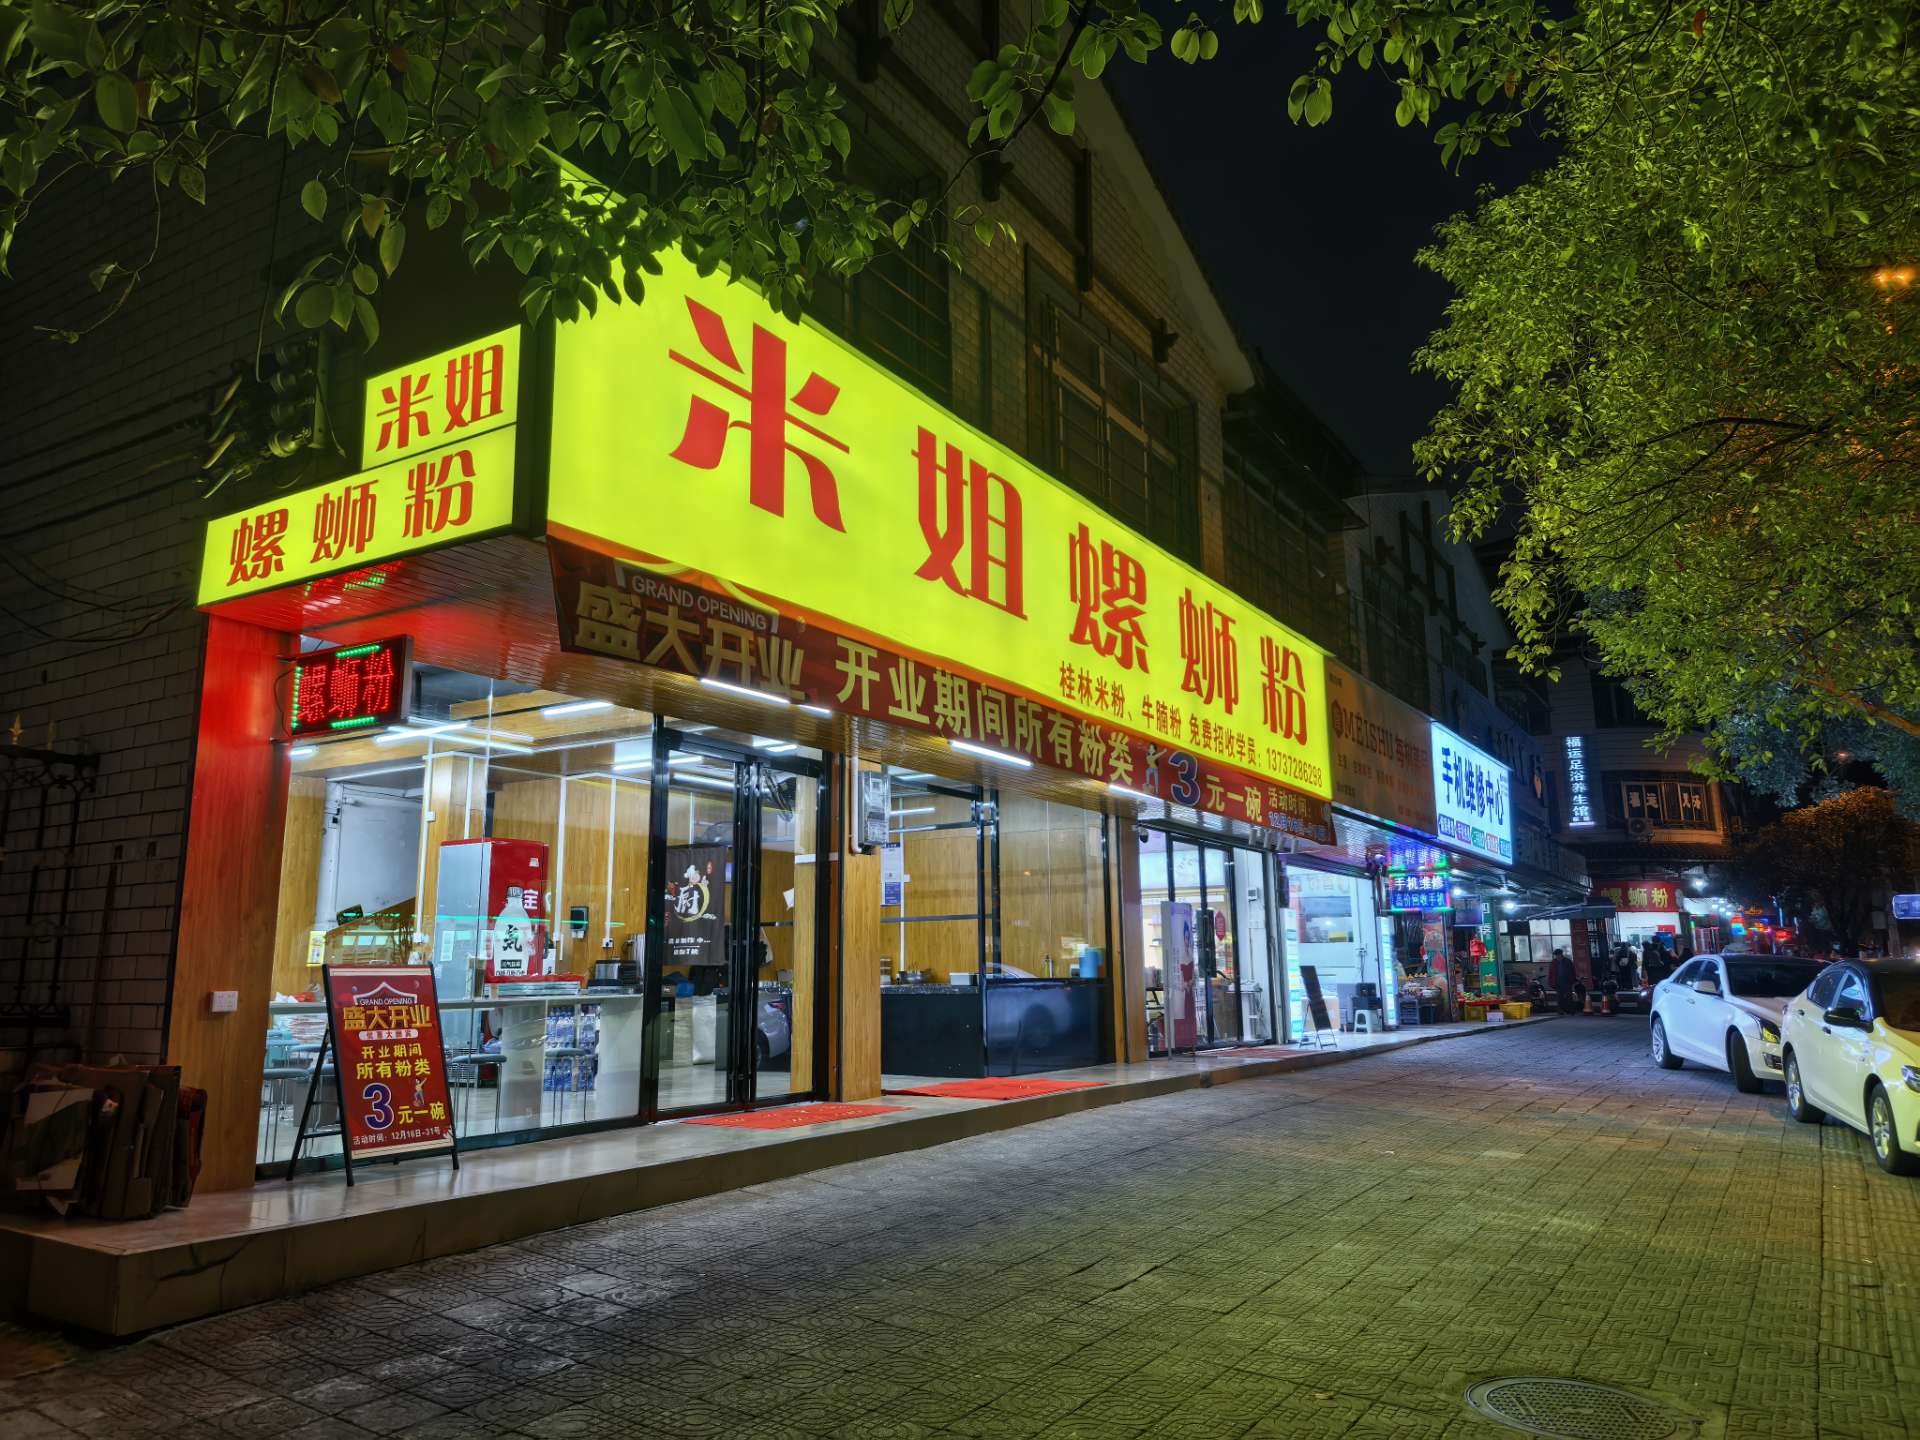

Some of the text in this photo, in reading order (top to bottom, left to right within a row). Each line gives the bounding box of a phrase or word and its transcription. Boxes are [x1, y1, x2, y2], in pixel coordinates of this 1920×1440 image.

[375, 344, 504, 452] 米姐
[225, 449, 477, 587] 螺蛳粉
[631, 574, 767, 632] GRAND OPENING
[574, 581, 806, 701] 盛大开业
[835, 637, 1134, 785] 开业期间所有粉类
[1442, 747, 1503, 826] 手机维修中心
[343, 1004, 433, 1031] 盛大开业
[361, 1043, 423, 1060] 开业期间
[356, 1058, 431, 1080] 所有粉类
[363, 1083, 446, 1130] 3 元一碗
